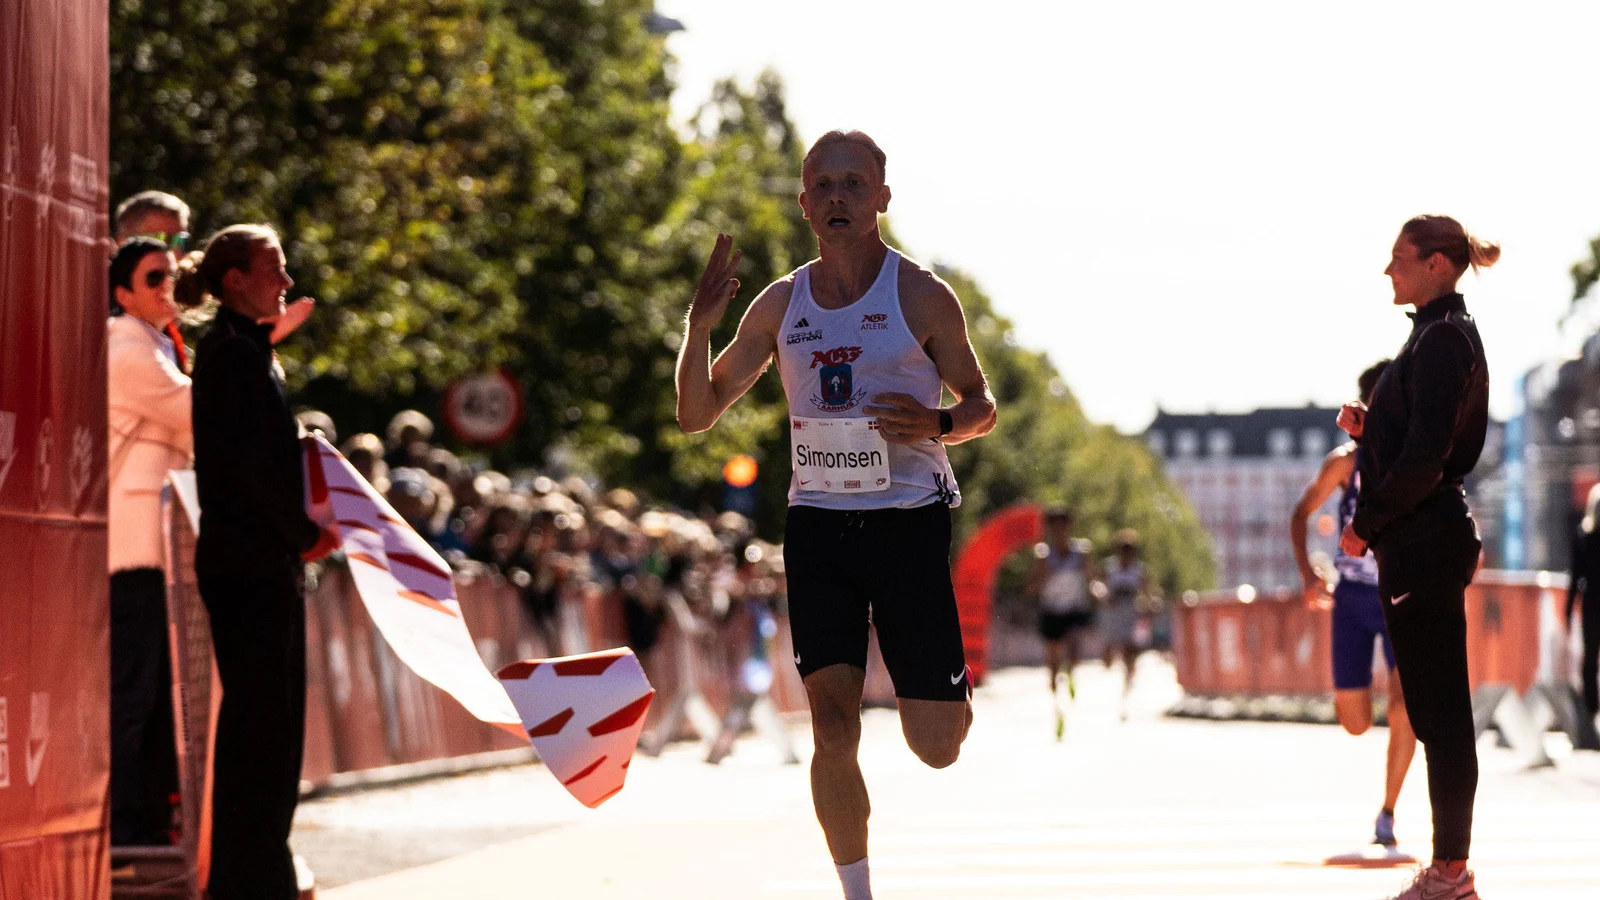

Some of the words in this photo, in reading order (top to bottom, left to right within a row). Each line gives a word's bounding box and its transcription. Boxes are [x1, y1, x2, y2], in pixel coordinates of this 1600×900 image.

[860, 322, 889, 331] ATLETIK
[787, 334, 822, 345] MOTION
[821, 401, 854, 411] AARHUS
[797, 445, 882, 468] Simonsen
